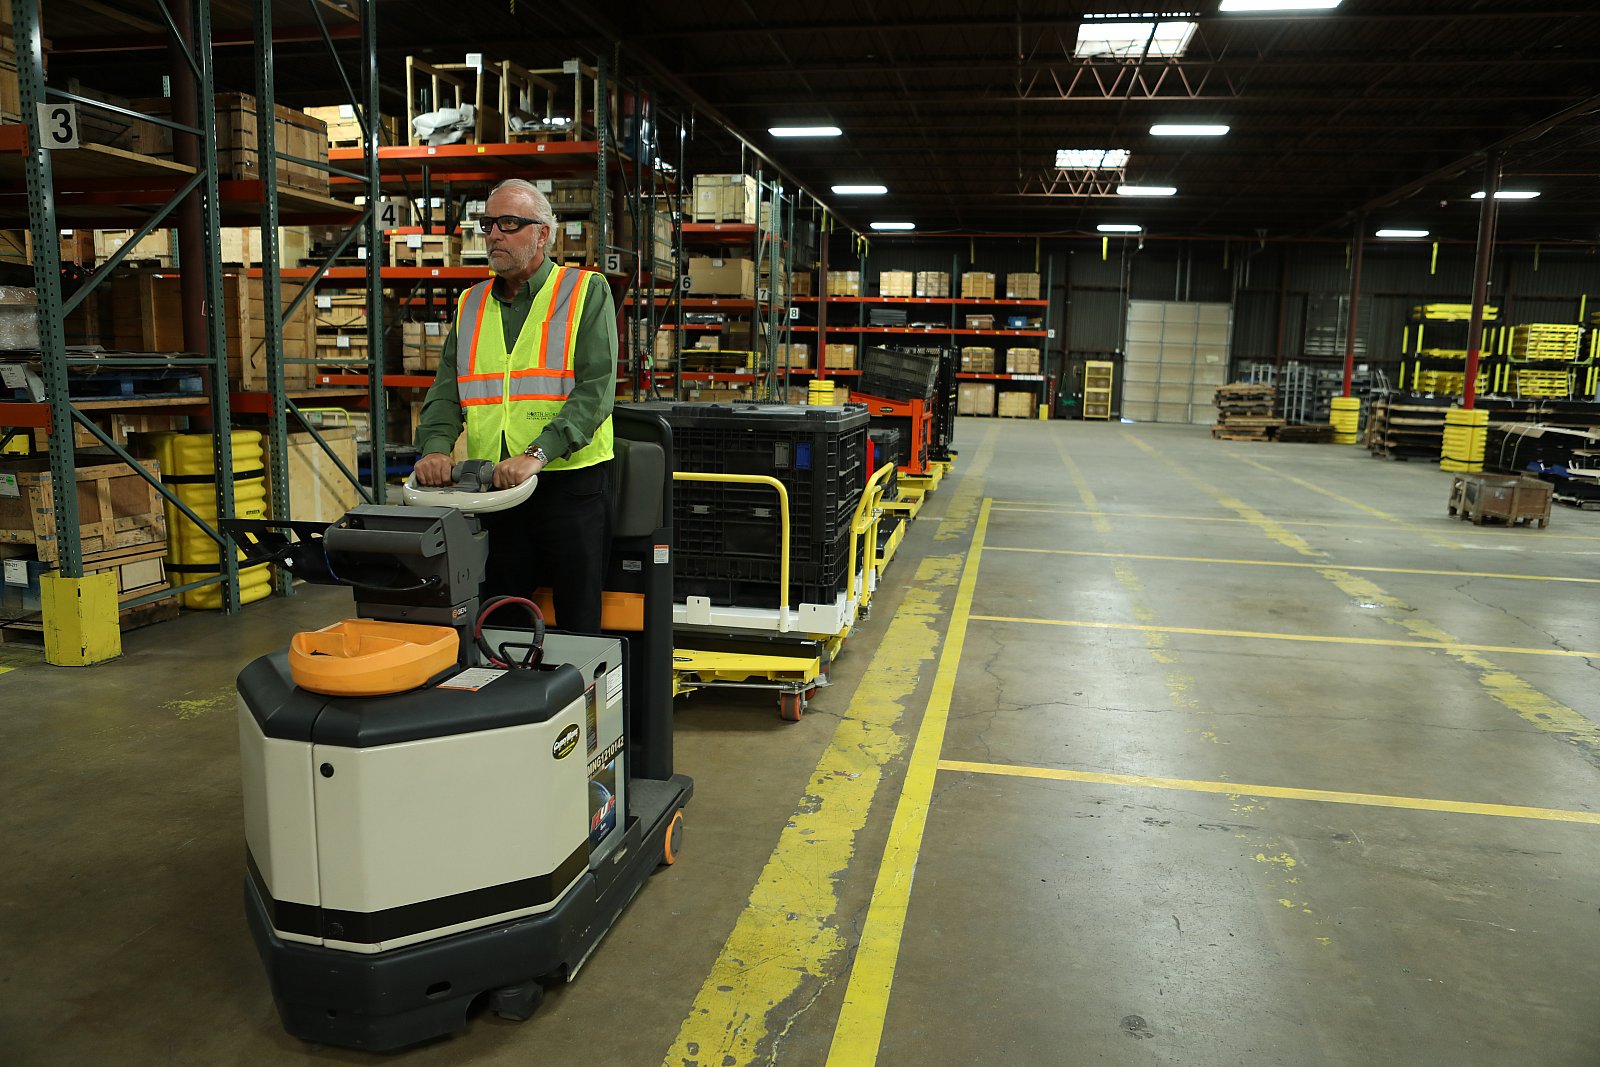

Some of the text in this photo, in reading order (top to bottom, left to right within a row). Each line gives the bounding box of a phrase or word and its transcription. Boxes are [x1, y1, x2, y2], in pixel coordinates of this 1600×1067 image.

[51, 108, 73, 143] 3
[381, 204, 396, 226] 4
[607, 255, 618, 270] 5
[682, 276, 691, 289] 6
[760, 289, 767, 298] 7
[790, 309, 798, 318] 8
